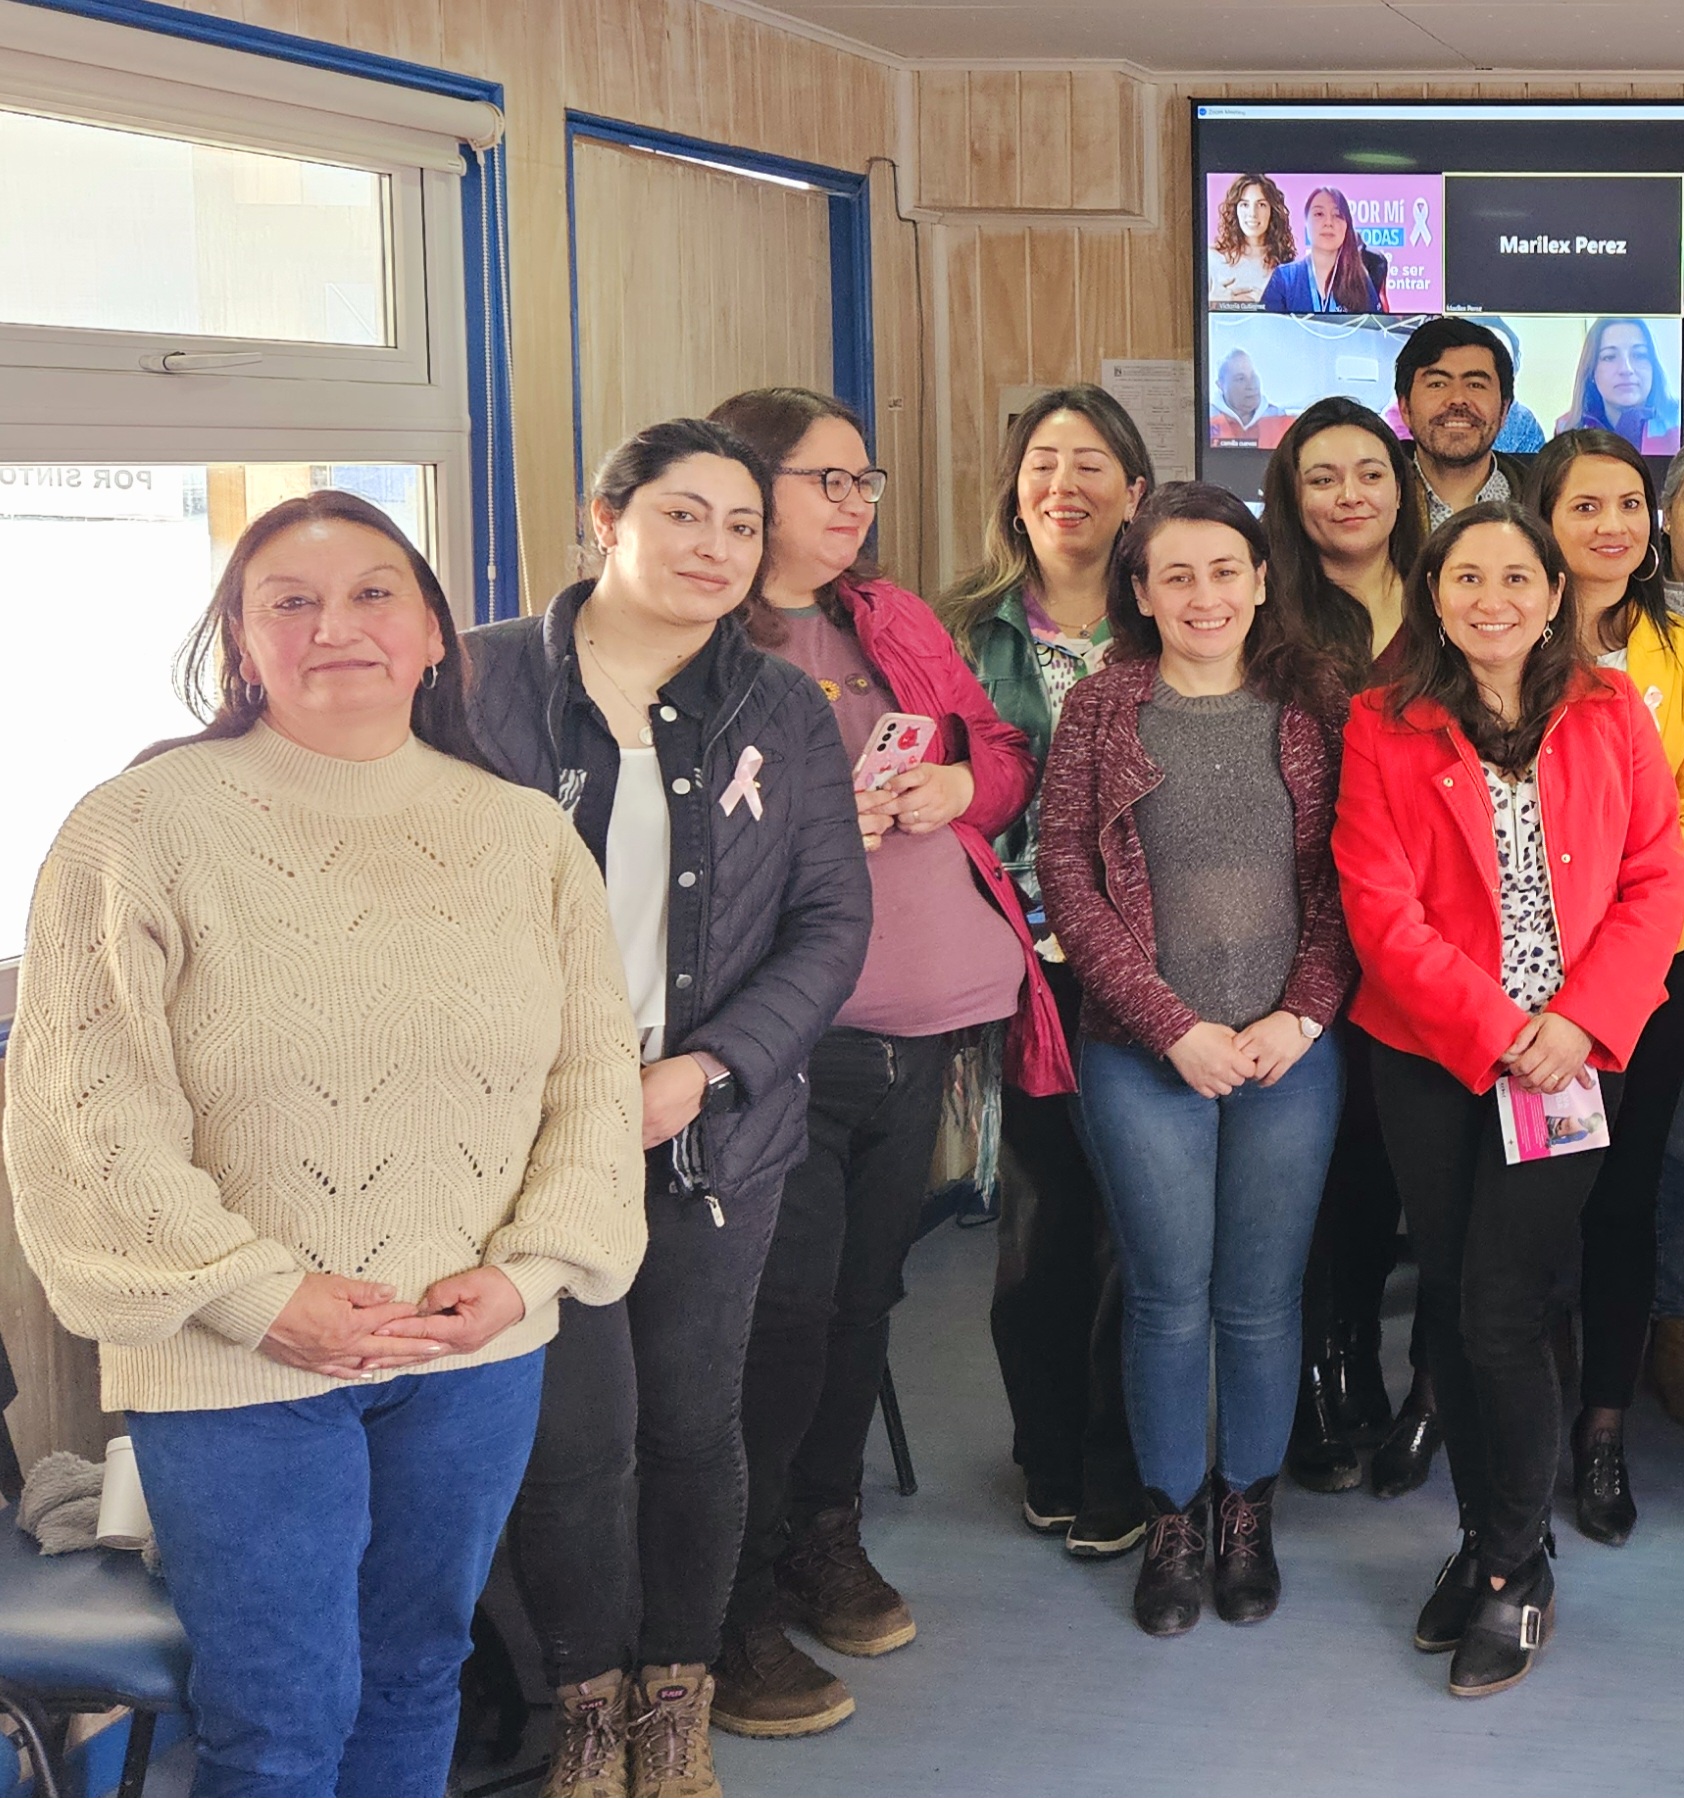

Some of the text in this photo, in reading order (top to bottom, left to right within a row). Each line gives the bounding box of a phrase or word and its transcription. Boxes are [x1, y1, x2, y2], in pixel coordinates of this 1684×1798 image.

[1500, 234, 1627, 255] Marilex Perez
[1402, 266, 1424, 277] ser
[1388, 278, 1430, 290] ontrar
